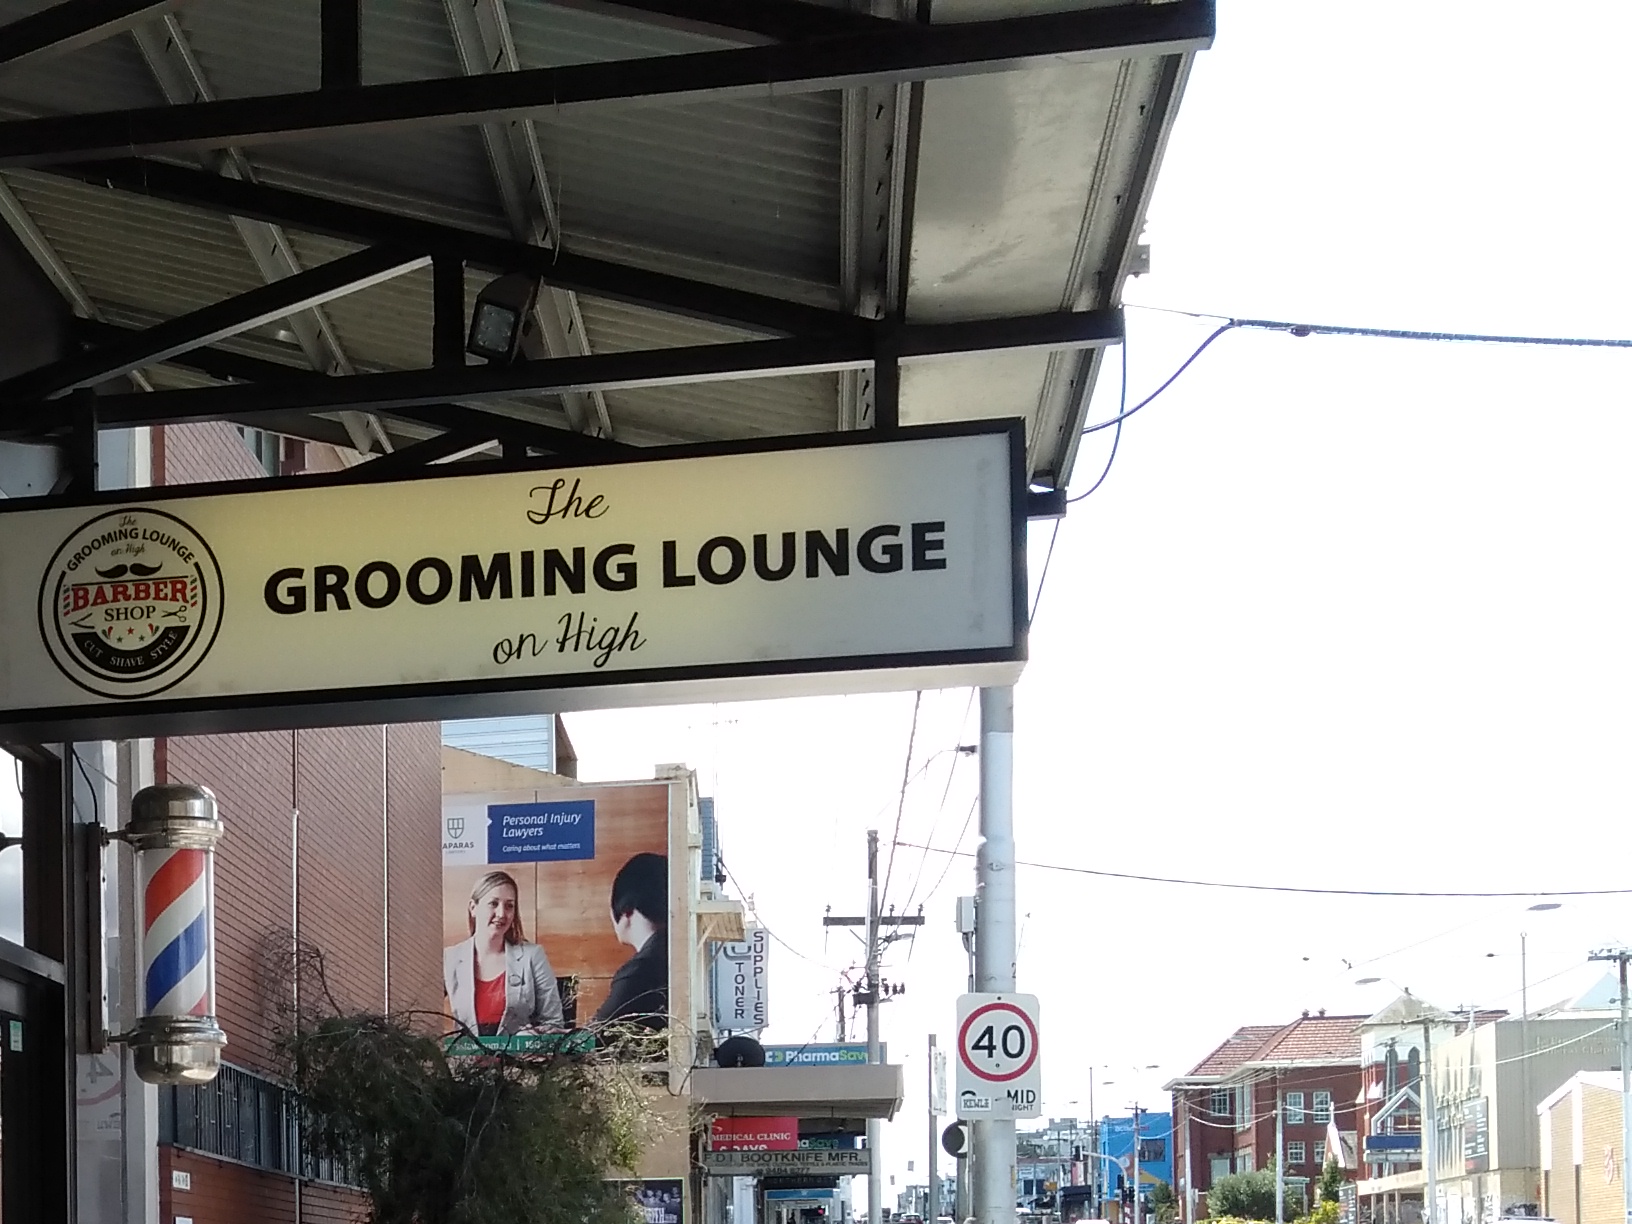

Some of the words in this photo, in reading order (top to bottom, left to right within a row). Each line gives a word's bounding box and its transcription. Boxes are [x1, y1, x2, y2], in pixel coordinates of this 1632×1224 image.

[526, 477, 610, 525] The
[67, 527, 140, 572] GROOMING
[142, 528, 195, 564] LOUNGE
[263, 542, 638, 615] GROOMING
[662, 520, 947, 589] LOUNGE
[70, 579, 190, 613] BARBER
[103, 605, 156, 622] SHOP
[84, 639, 104, 658] CUT
[109, 655, 145, 667] SHAVE
[149, 629, 179, 660] STYLE
[492, 632, 549, 665] on
[555, 610, 647, 668] High
[502, 812, 548, 827] Personal
[549, 812, 582, 825] Injury
[502, 826, 544, 839] Lawyers
[502, 844, 523, 854] Caring
[522, 842, 541, 852] about
[541, 841, 557, 851] what
[557, 841, 581, 851] matters
[734, 962, 745, 1019] TONER
[753, 931, 764, 1025] SUPPLIES
[971, 1024, 1026, 1059] 40
[1006, 1089, 1036, 1104] MID
[712, 1133, 755, 1142] MEDICAL
[756, 1132, 791, 1141] CLINIC
[741, 1152, 823, 1163] BOOTKNIFE
[827, 1152, 862, 1162] MFR.
